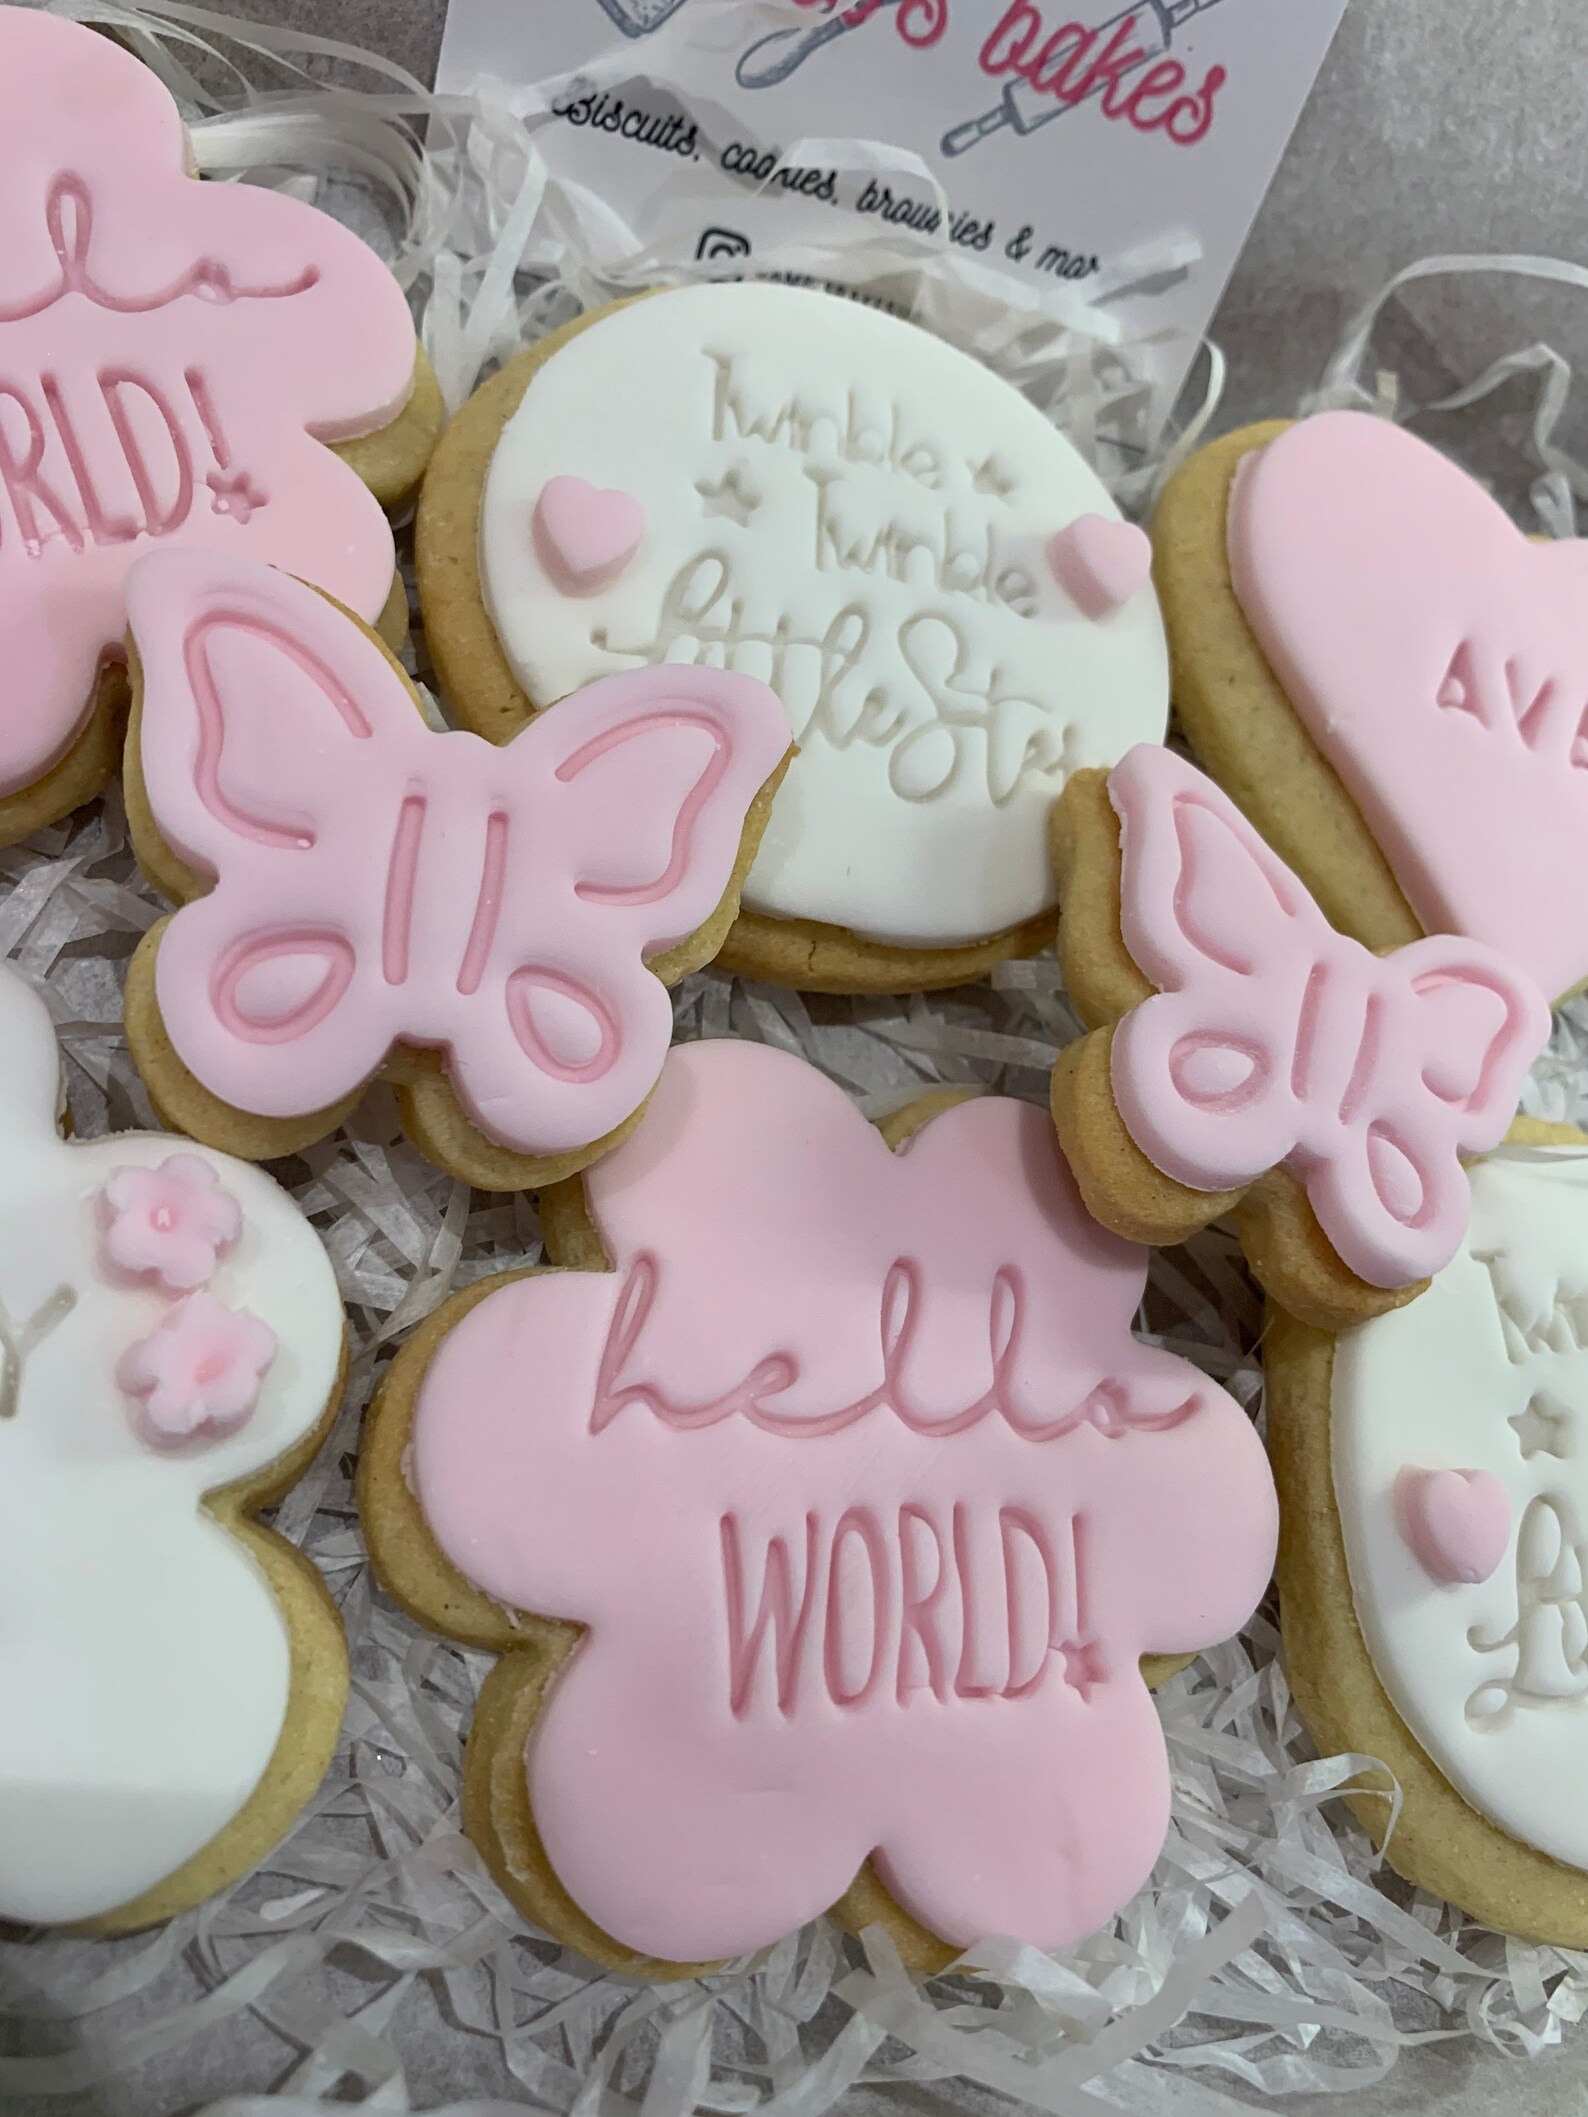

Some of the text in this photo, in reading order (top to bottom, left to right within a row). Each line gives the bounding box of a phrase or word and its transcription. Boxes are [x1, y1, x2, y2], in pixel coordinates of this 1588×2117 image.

[978, 0, 1227, 146] bakes
[720, 141, 839, 205] cooies,
[855, 178, 996, 251] browies
[1003, 222, 1035, 262] &
[0, 365, 271, 558] RLD!
[588, 1250, 1204, 1443] hello
[719, 1499, 1113, 1722] WORLD!
